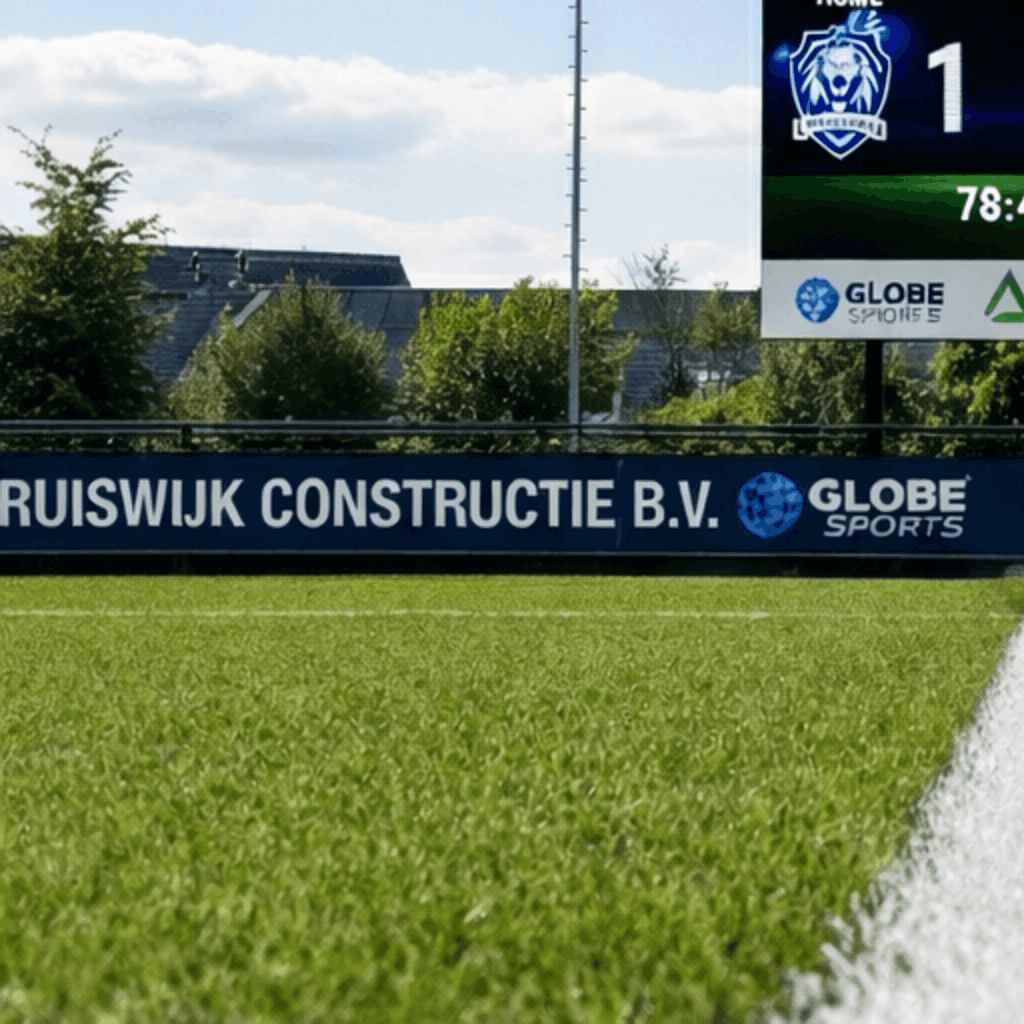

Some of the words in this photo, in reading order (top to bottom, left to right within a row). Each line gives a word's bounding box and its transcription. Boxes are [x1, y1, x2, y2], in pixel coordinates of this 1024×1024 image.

[927, 41, 962, 133] 1
[845, 281, 945, 305] GLOBE
[0, 477, 245, 528] RUISWIJK
[261, 477, 615, 529] CONSTRUCTIE
[634, 479, 719, 528] B.V.
[808, 477, 967, 513] GLOBE
[823, 514, 964, 538] SPORTS
